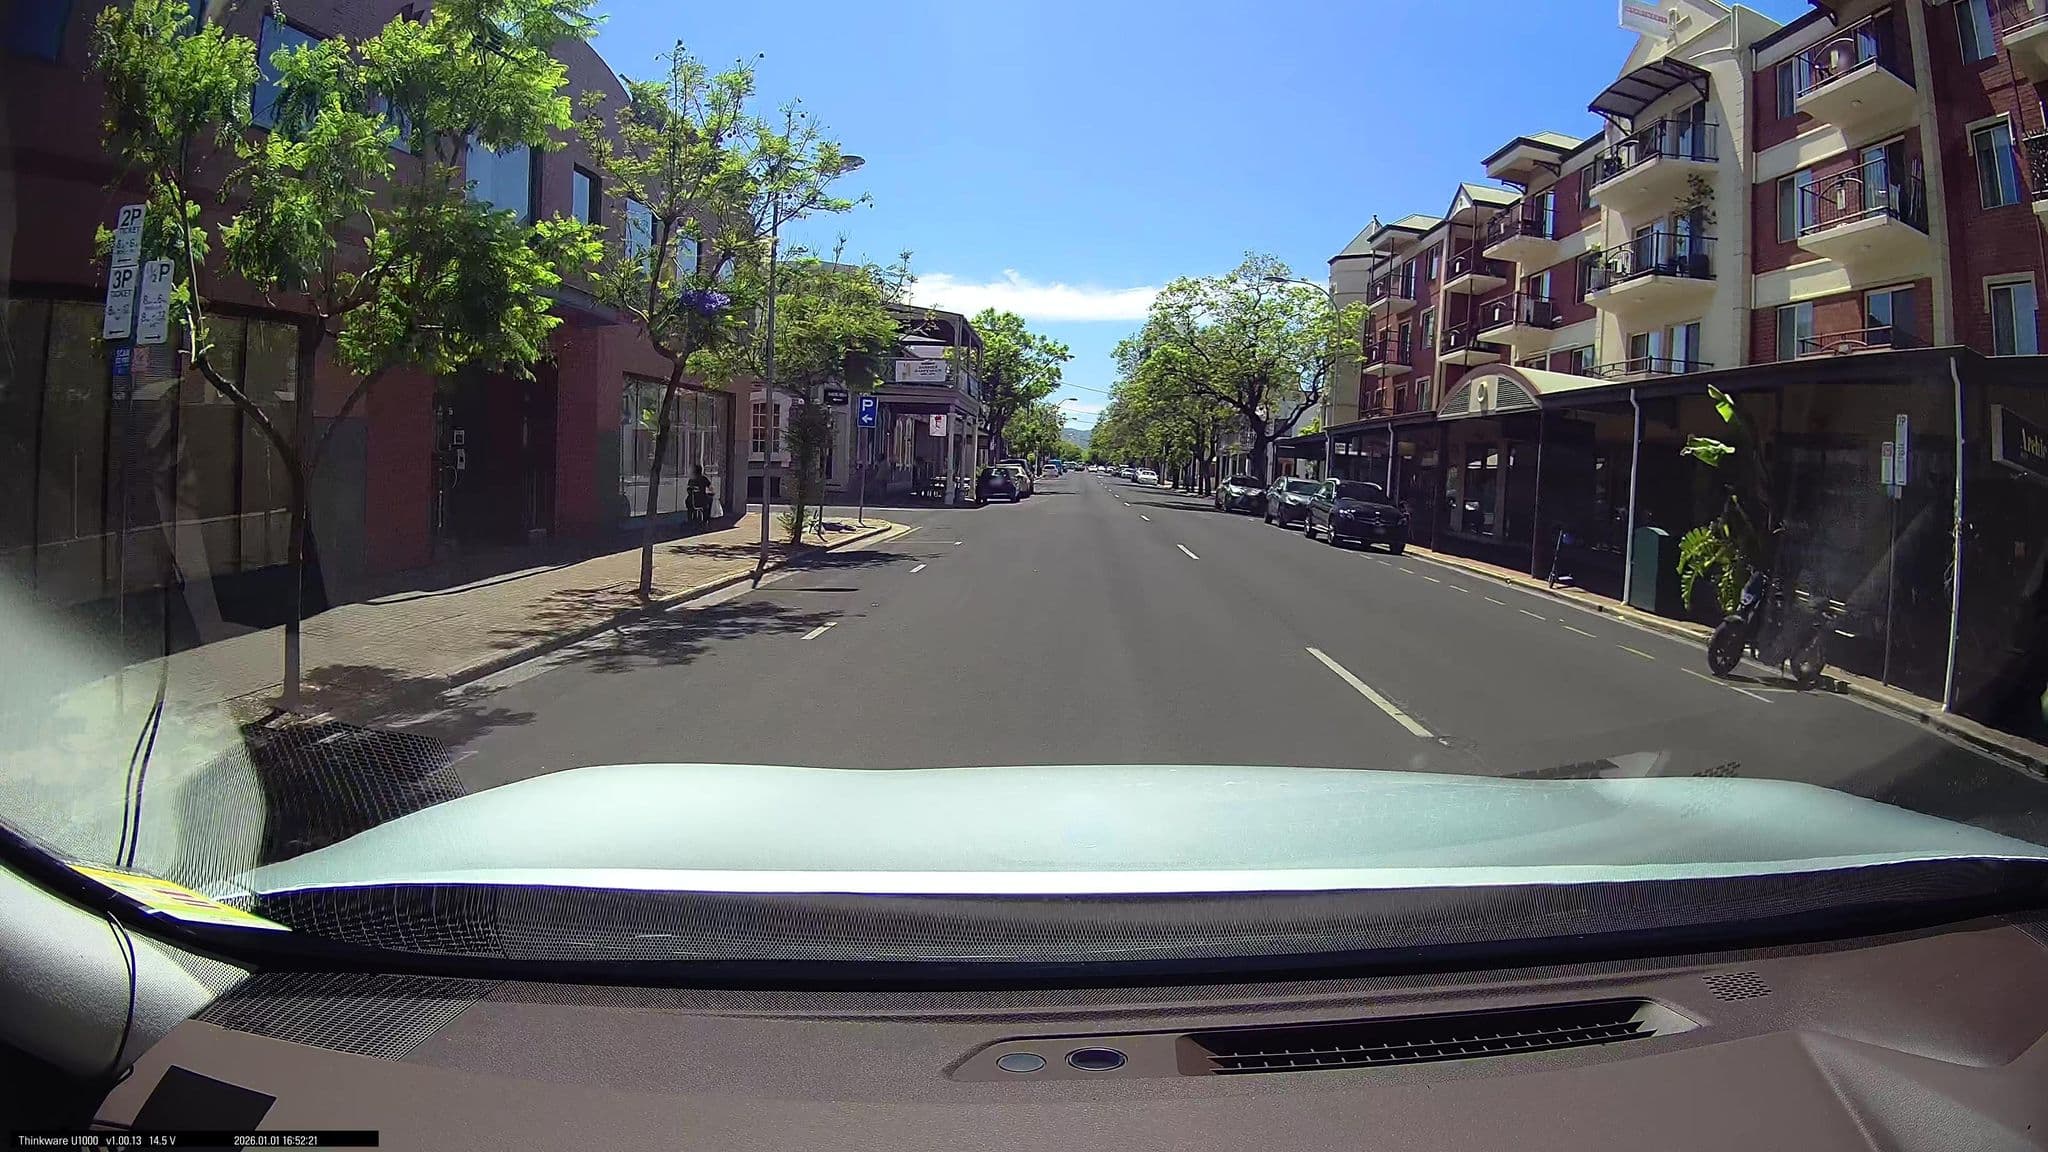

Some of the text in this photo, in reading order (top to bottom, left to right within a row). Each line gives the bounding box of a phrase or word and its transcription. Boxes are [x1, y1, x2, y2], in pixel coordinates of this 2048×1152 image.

[121, 208, 142, 227] 2P
[112, 269, 133, 289] 3P
[862, 399, 874, 412] P
